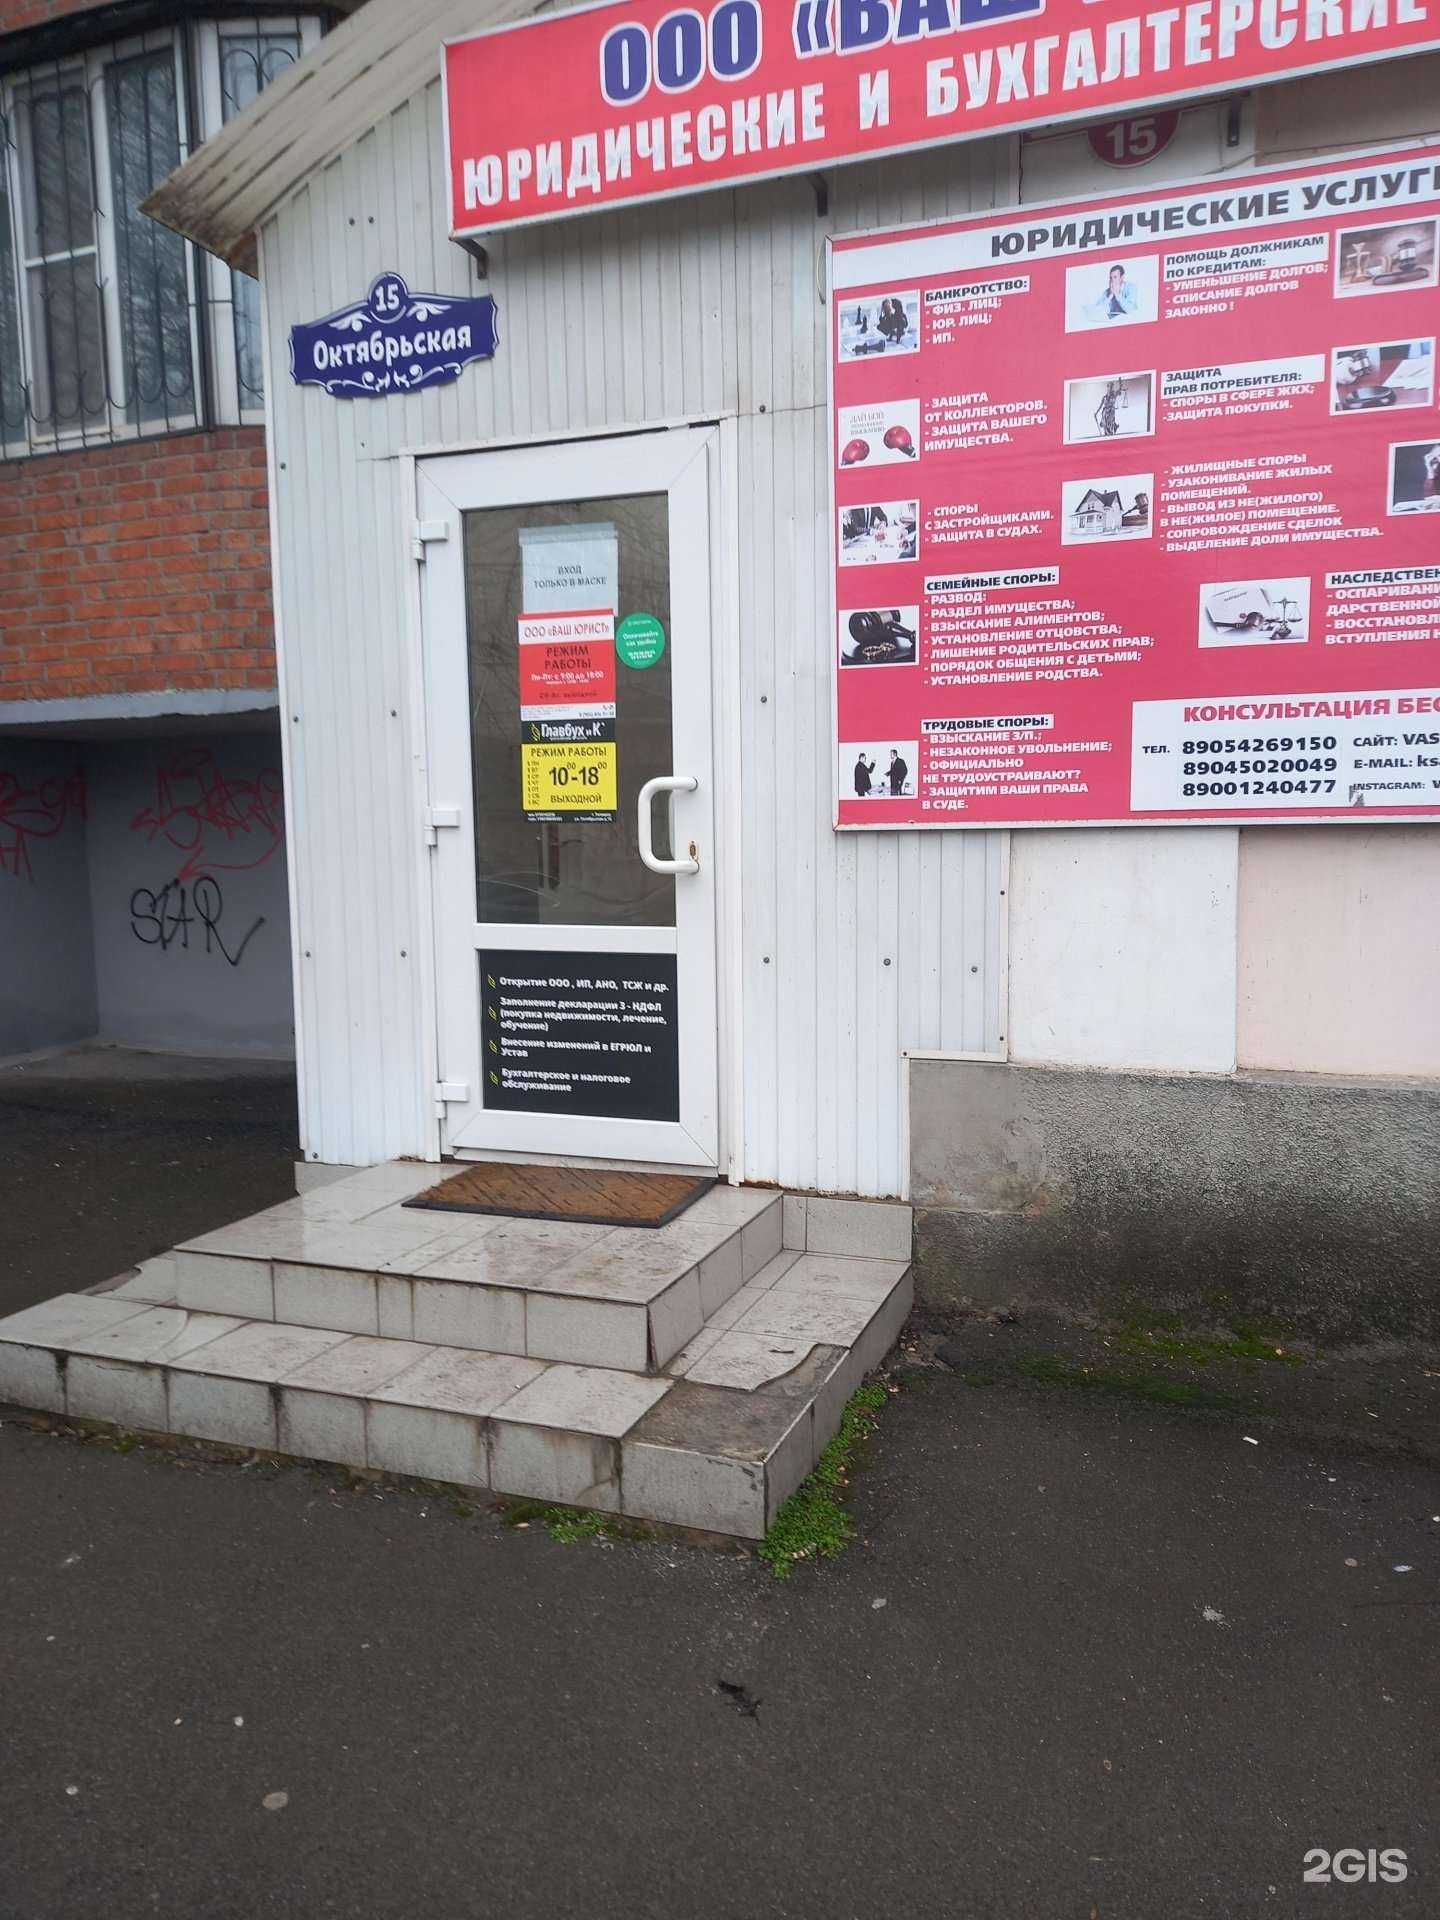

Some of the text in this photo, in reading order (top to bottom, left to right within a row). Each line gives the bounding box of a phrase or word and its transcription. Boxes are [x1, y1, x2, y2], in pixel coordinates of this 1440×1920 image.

[601, 0, 762, 106] ООО
[464, 83, 826, 210] ЮРИДИЧЕСКИЕ
[858, 70, 890, 130] И
[1104, 116, 1157, 159] 15
[992, 190, 1289, 258] ЮРИДИЧЕСКИЕ
[1166, 236, 1324, 265] ПОМОЩЬ ДОЛЖНИКАМ
[1166, 258, 1266, 279] ПО КРЕДИТАМ:
[1172, 263, 1328, 291] УМЕНЬШЕНИЕ ДОЛГОВ;
[375, 283, 400, 311] 15
[926, 280, 1028, 302] БАНКРОТСТВО:
[1173, 281, 1298, 304] СПИСАНИЕ ДОЛГОВ
[933, 302, 965, 315] ФИЗ.
[1165, 303, 1227, 319] ЗАКОННО
[932, 333, 955, 344] ИП.
[313, 325, 471, 370] Октябрьская
[1164, 372, 1302, 396] ПРАВ ПОТРЕБИТЕЛЯ:
[1166, 368, 1222, 383] ЗАЩИТА
[932, 392, 988, 409] ЗАЩИТА
[1170, 394, 1217, 408] СПОРЫ
[1219, 392, 1229, 402] В
[1230, 386, 1275, 401] СФЕРЕ
[925, 399, 1047, 424] ОТ КОЛЛЕКТОРОВ.
[1225, 400, 1293, 415] ПОКУПКИ.
[931, 414, 1047, 436] ЗАЩИТА ВАШЕГО
[925, 433, 1013, 451] ИМУЩЕСТВА.
[1171, 454, 1307, 476] ЖИЛИЩНЫЕ СПОРЫ
[1167, 464, 1333, 489] УЗАКОНИВАНИЕ ЖИЛЫХ
[1161, 484, 1251, 502] ПОМЕЩЕНИЙ.
[934, 504, 979, 517] СПОРЫ
[1167, 491, 1323, 514] ВЫВОД ИЗ НЕ(ЖИЛОГО)
[924, 510, 1054, 531] С ЗАСТРОЙЩИКАМИ.
[1160, 504, 1340, 527] В НЕ(ЖИЛОЕ) ПОМЕЩЕНИЕ.
[931, 524, 1043, 543] ЗАЩИТА В СУДАХ.
[1166, 516, 1343, 540] СОПРОВОЖДЕНИЕ СДЕЛОК
[1166, 527, 1384, 553] ВЫДЕЛЕНИЕ ДОЛИ ИМУЩЕСТВА.
[558, 566, 583, 575] ВХОД
[534, 578, 568, 589] ТОЛЬКО
[577, 576, 607, 586] МАСКЕ
[926, 572, 1056, 591] СЕМЕЙНЫЕ СПОРЫ:
[931, 606, 983, 619] РАЗДЕЛ
[524, 626, 546, 638] ООО
[931, 618, 1012, 633] ВЗЫСКАНИЕ
[931, 630, 1034, 646] УСТАНОВЛЕНИЕ
[1325, 629, 1431, 645] ВСТУПЛЕНИЯ
[546, 645, 589, 657] РЕЖИМ
[930, 646, 997, 660] ЛИШЕНИЕ
[998, 638, 1111, 656] РОДИТЕЛЬСКИХ
[544, 659, 592, 670] РАБОТЫ
[931, 660, 993, 674] ПОРЯДОК
[996, 655, 1064, 671] ОБЩЕНИЯ
[1066, 654, 1075, 665] С
[931, 667, 1103, 687] УСТАНОВЛЕНИЕ РОДСТВА.
[1184, 699, 1391, 722] КОНСУЛЬТАЦИЯ
[541, 722, 585, 740] Главбух
[923, 716, 1049, 732] ТРУДОВЫЕ СПОРЫ:
[930, 731, 1010, 745] ВЗЫСКАНИЕ
[1142, 736, 1337, 755] ТЕЛ. 89054269150
[1353, 734, 1398, 747] САЙТ:
[531, 747, 607, 757] РЕЖИМ РАБОТЫ
[930, 745, 1016, 758] НЕЗАКОННОЕ
[930, 758, 1025, 771] ОФИЦИАЛЬНО
[1183, 758, 1337, 776] 89045020049
[1354, 754, 1440, 769] E-MAIL: ks
[923, 769, 1082, 785] НЕ ТРУДОУСТРАИВАЮТ?
[929, 782, 1089, 798] ЗАЩИТИМ ВАШИ ПРАВА
[1182, 780, 1337, 797] 89001240477
[1353, 782, 1426, 791] INSTAGRAM:
[550, 792, 602, 804] ВЫХОДНОЙ
[922, 799, 969, 811] В СУДЕ.
[500, 976, 548, 988] Открытие
[576, 979, 594, 990] ИП,
[595, 980, 618, 991] АНО,
[622, 980, 644, 991] ТСЖ
[653, 982, 670, 994] др.
[500, 996, 557, 1008] Заполнение
[558, 1000, 618, 1011] декларации
[632, 1001, 662, 1013] НДФЛ
[500, 1009, 667, 1025] (покупка недвижимости, лечение,
[500, 1020, 549, 1032] обучение)
[500, 1048, 529, 1058] Устав
[501, 1037, 546, 1048] Внесение
[546, 1039, 601, 1051] изменений
[610, 1042, 643, 1053] ЕГРЮЛ
[502, 1068, 571, 1081] Бухгалтерское
[580, 1073, 632, 1084] налоговое
[502, 1080, 572, 1093] обслуживание
